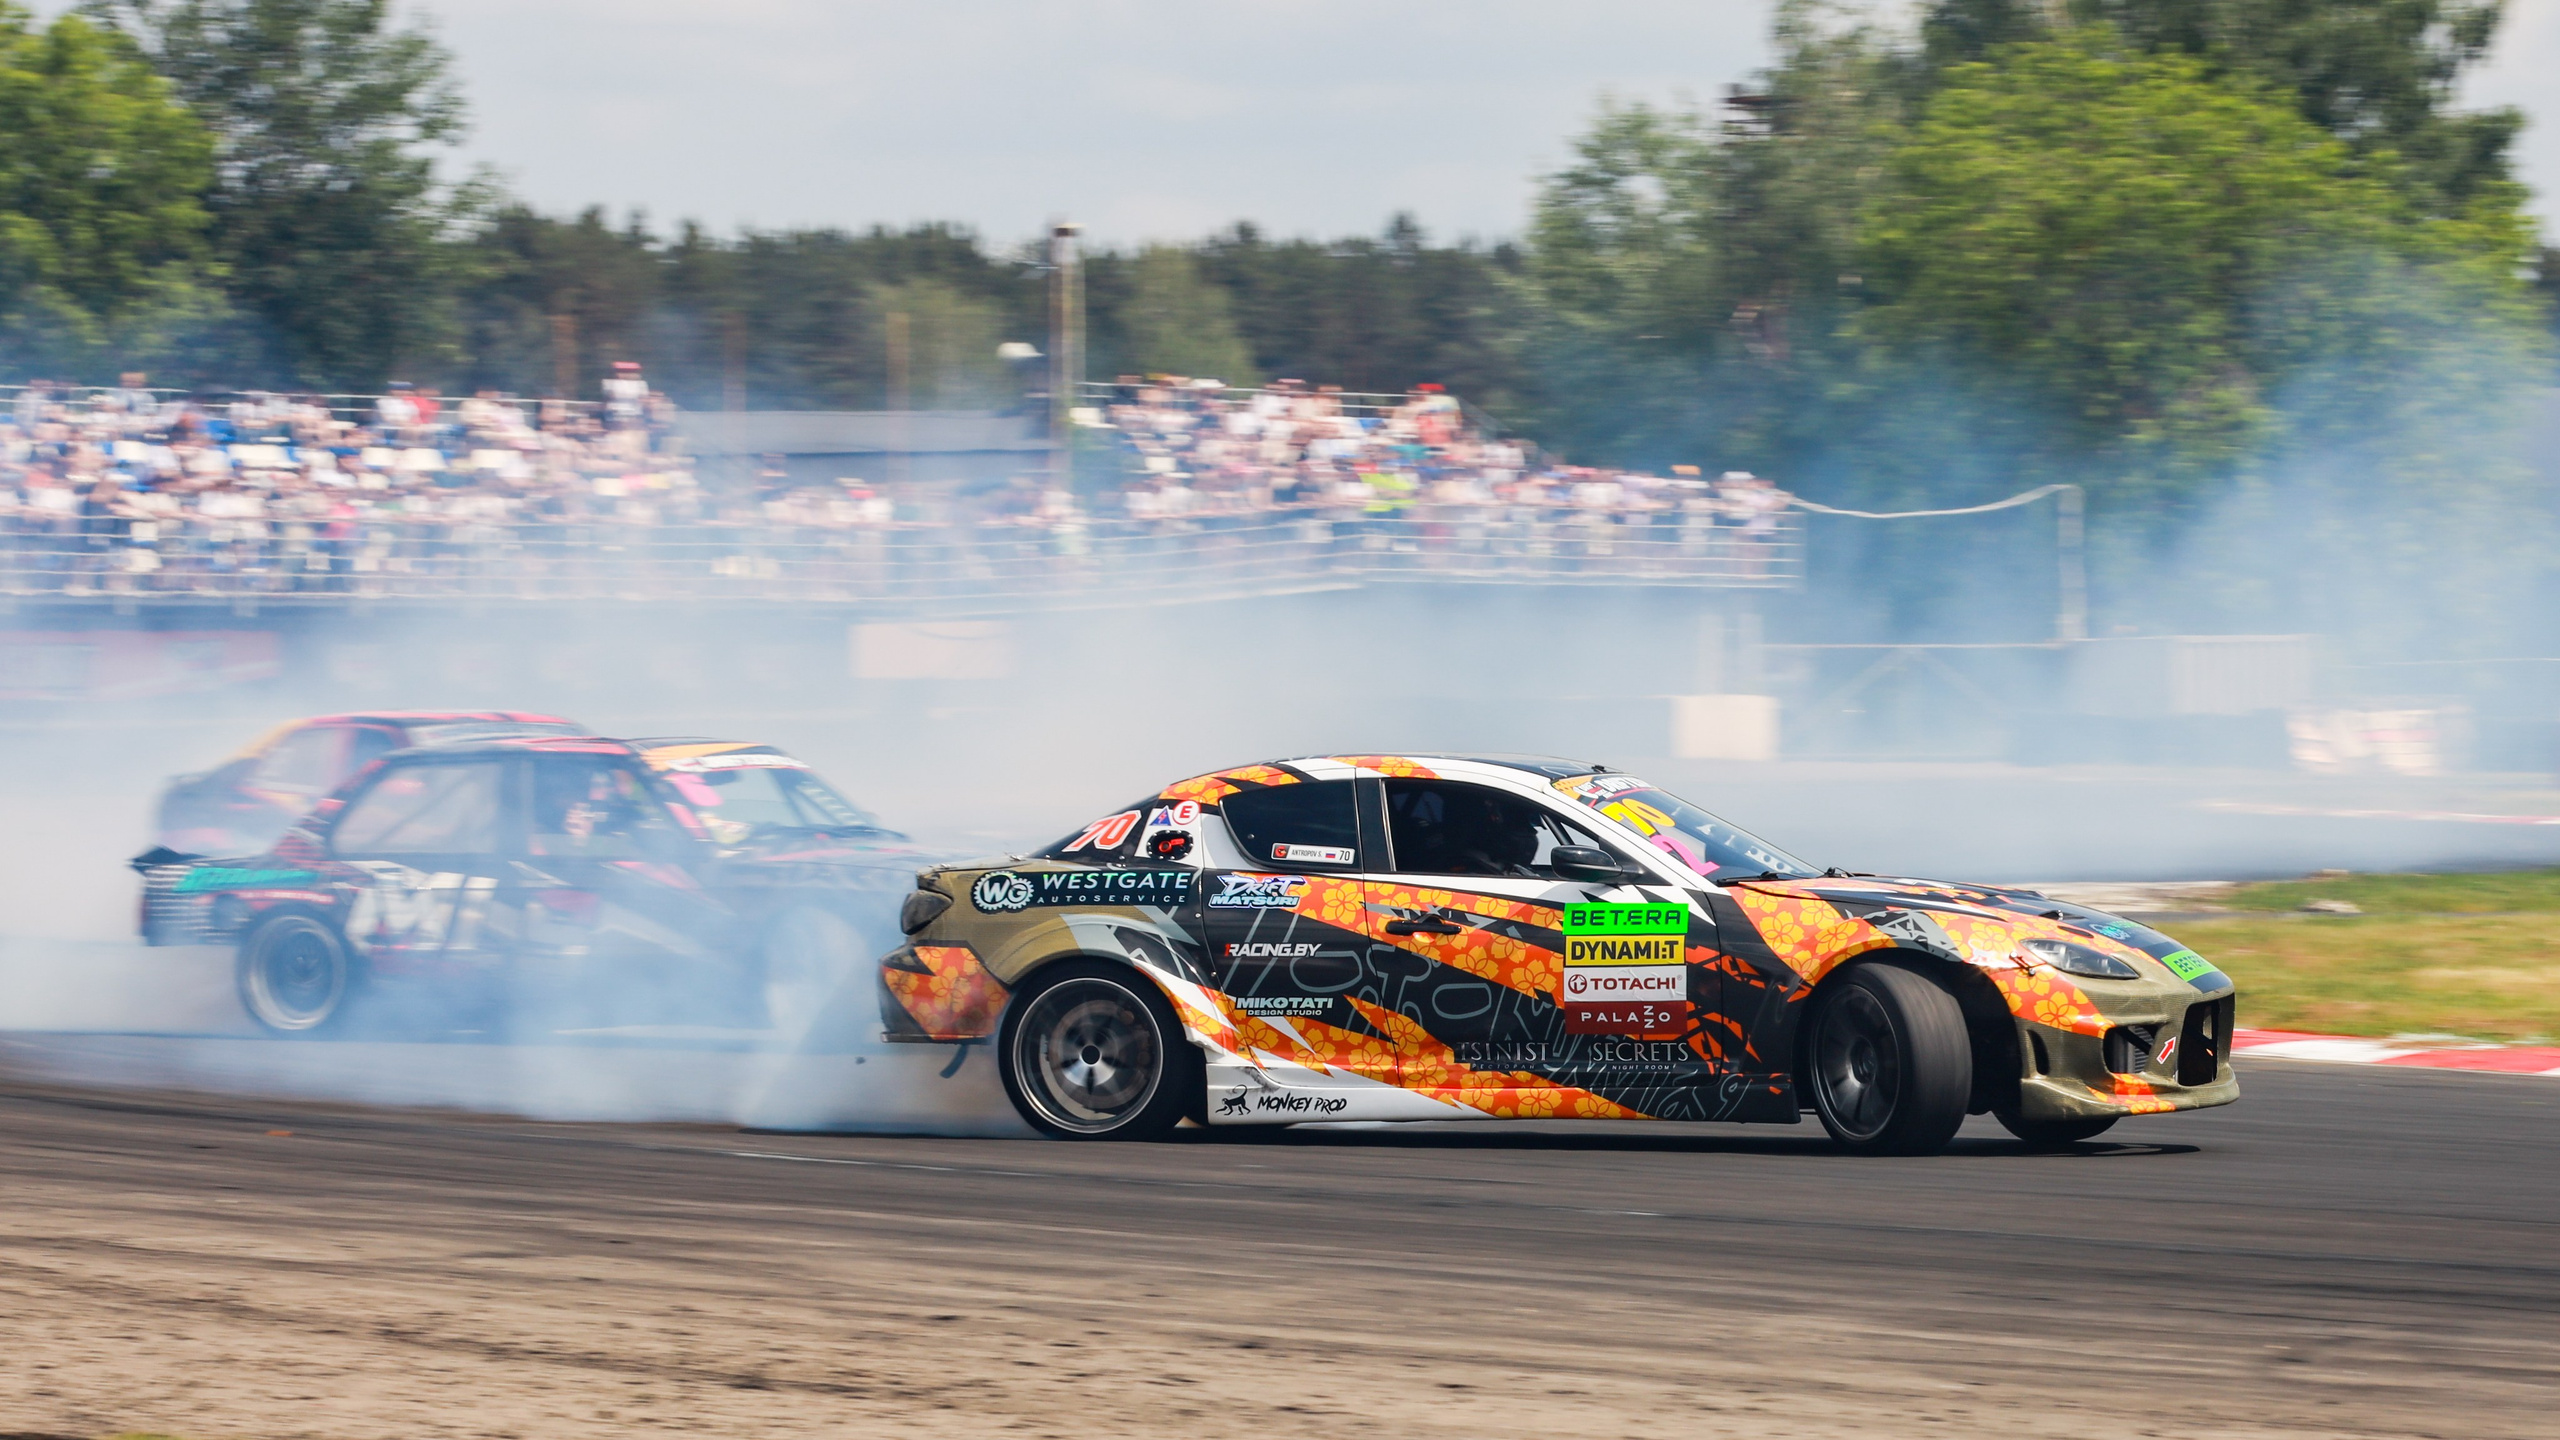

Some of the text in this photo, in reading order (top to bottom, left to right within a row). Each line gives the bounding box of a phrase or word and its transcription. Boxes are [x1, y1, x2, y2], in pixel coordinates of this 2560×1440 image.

[1179, 806, 1193, 818] E
[1600, 798, 1676, 836] 70
[1061, 810, 1141, 852] 70
[1291, 849, 1317, 857] ANTROPOV
[1339, 850, 1351, 861] 70
[1043, 872, 1191, 890] WESTGATE
[1037, 894, 1186, 904] AUTOSERVICE
[1211, 895, 1300, 906] MATSURI
[1590, 977, 1676, 990] TOTACHI
[1236, 997, 1333, 1009] MIKOTATI
[1593, 1042, 1689, 1062] SECRETS
[1257, 1092, 1347, 1115] MONKEY PROD
